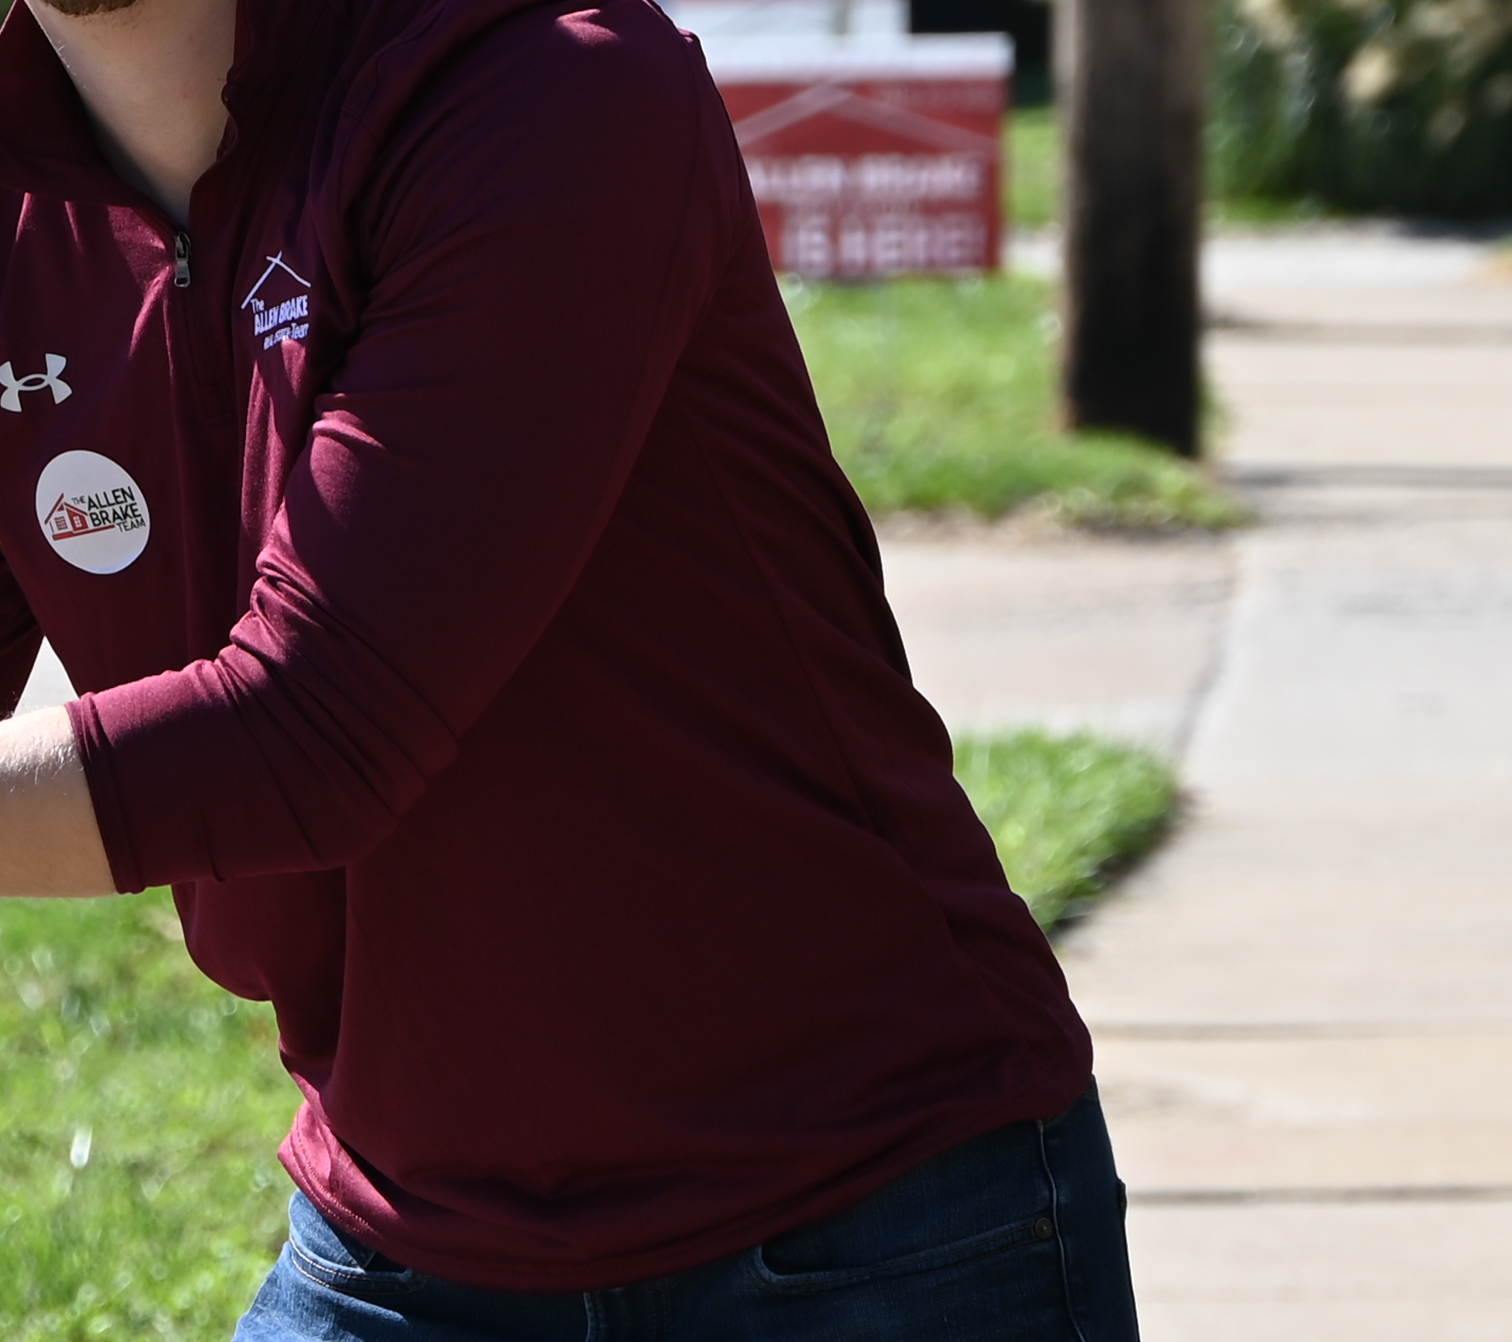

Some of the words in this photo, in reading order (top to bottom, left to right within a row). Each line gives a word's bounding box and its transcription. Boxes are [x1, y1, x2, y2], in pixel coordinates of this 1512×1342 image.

[250, 298, 265, 314] The
[71, 495, 87, 506] THE
[87, 485, 136, 512] ALLEN
[89, 502, 143, 528] BRAKE
[116, 517, 147, 533] TEAM
